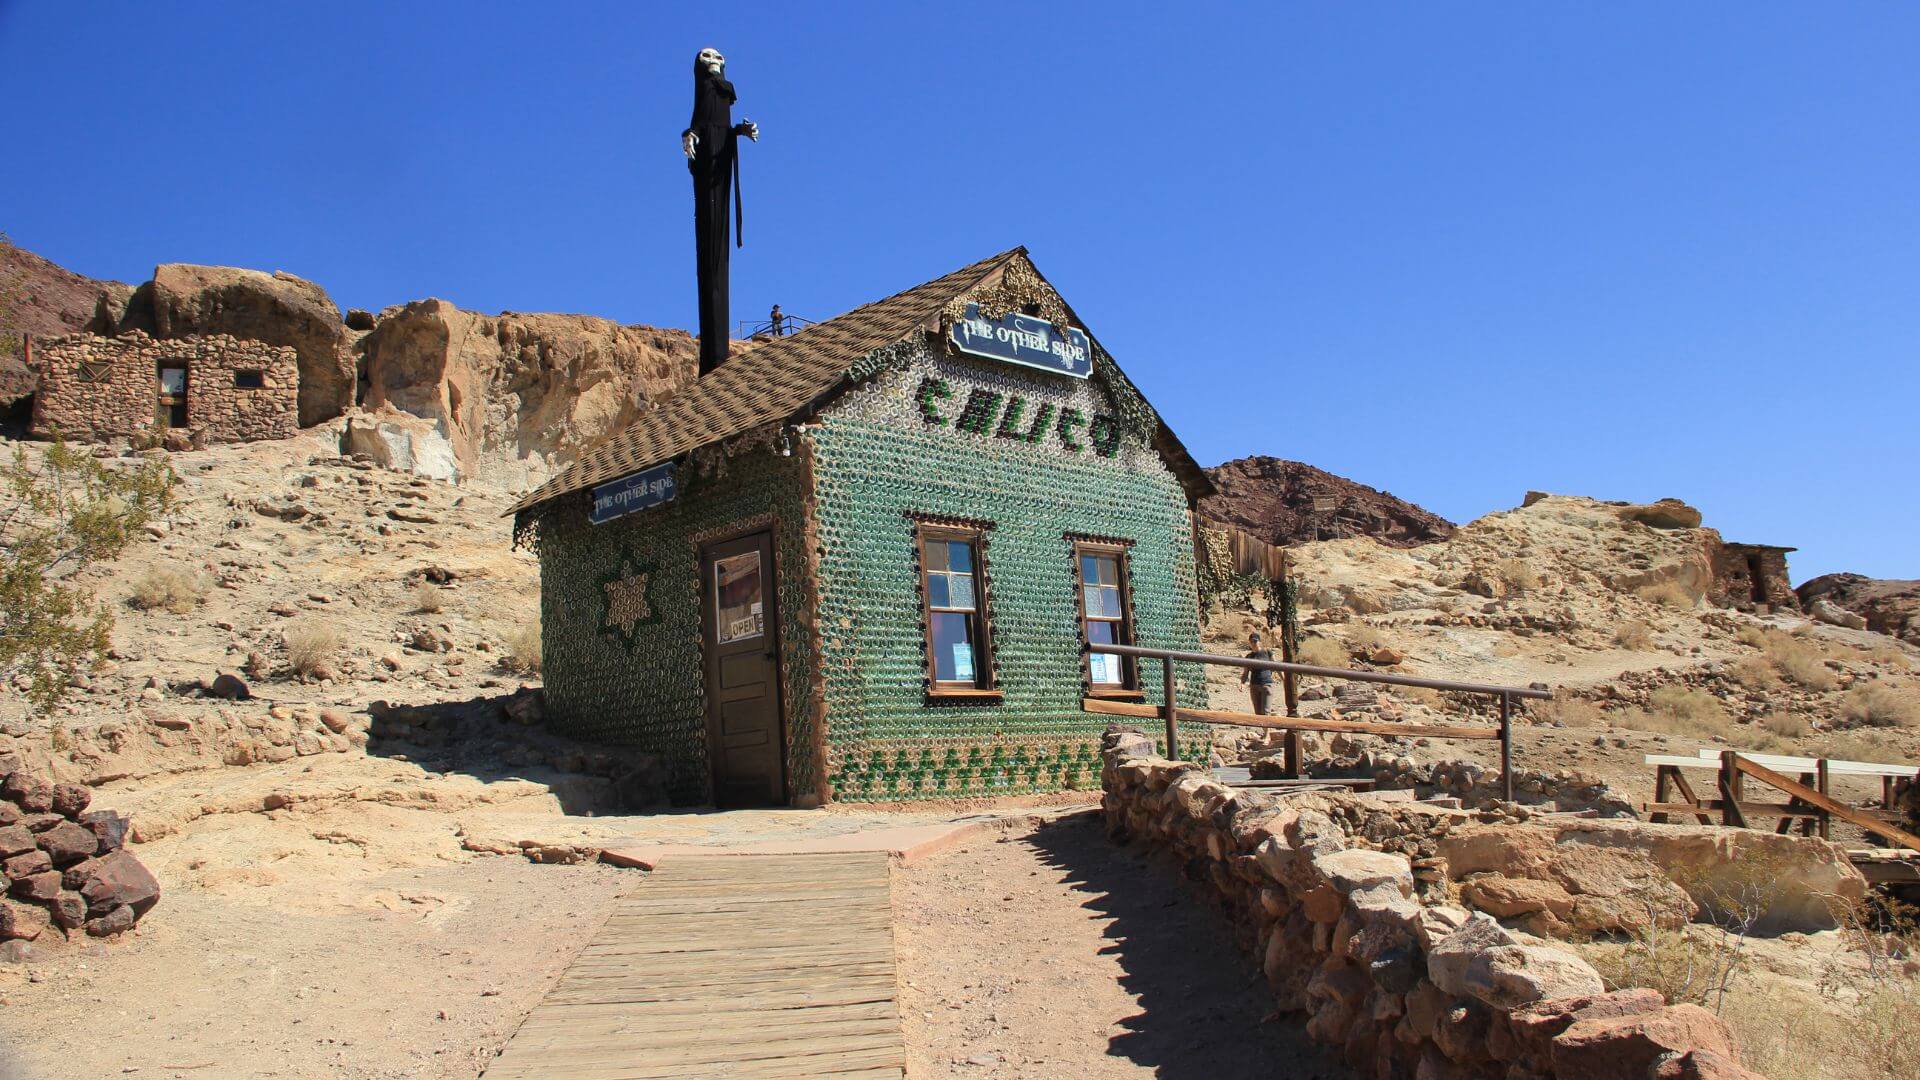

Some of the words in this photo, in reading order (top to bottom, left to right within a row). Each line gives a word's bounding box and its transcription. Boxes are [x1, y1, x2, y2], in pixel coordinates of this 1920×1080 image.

[962, 318, 994, 344] THE
[997, 326, 1050, 355] OTHER
[1051, 340, 1085, 369] SIDE
[594, 495, 613, 516] THE
[615, 484, 648, 507] OTHER
[649, 476, 673, 499] SIDE
[732, 617, 755, 636] OPEN
